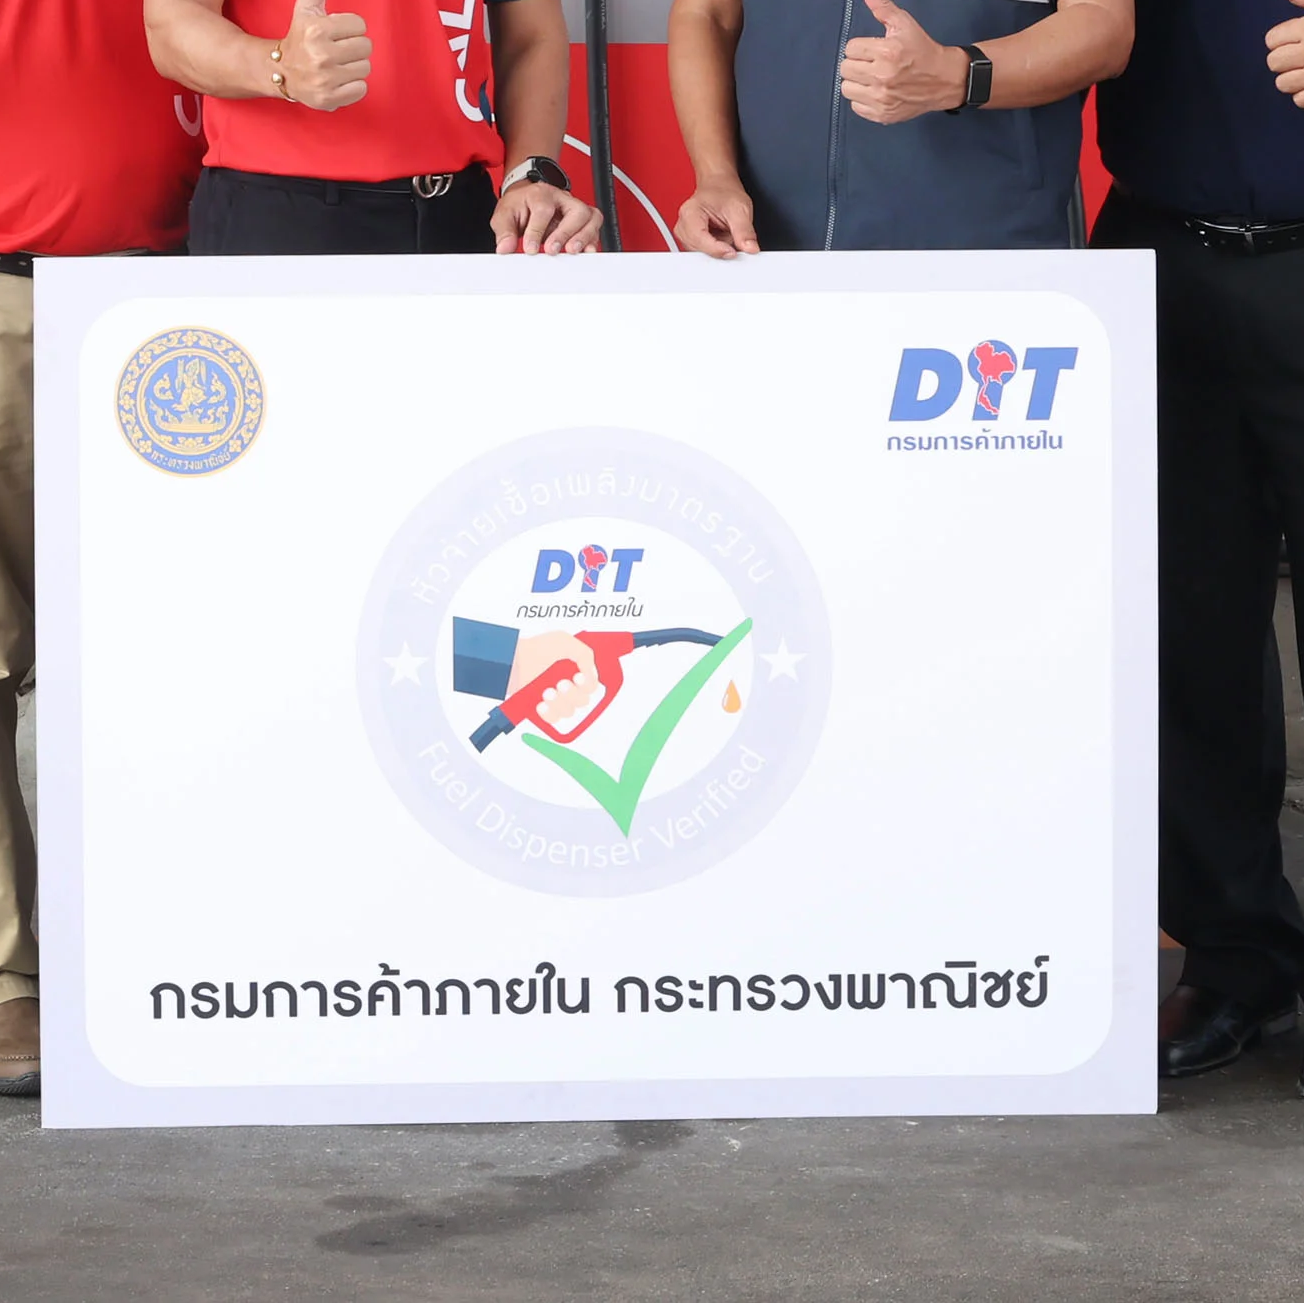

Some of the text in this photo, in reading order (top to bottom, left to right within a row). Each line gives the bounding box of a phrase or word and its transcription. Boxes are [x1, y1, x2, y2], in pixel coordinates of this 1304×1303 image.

[888, 339, 1079, 421] DIT
[887, 428, 1064, 451] กรมการค้าภายใน
[531, 544, 644, 593] DIT
[516, 596, 644, 618] กรมการค้าภายใน
[419, 739, 766, 868] Fuel Dispenser Verified
[150, 955, 1050, 1019] กรมการค้าภายใน กระทรวงพาณิชย์
